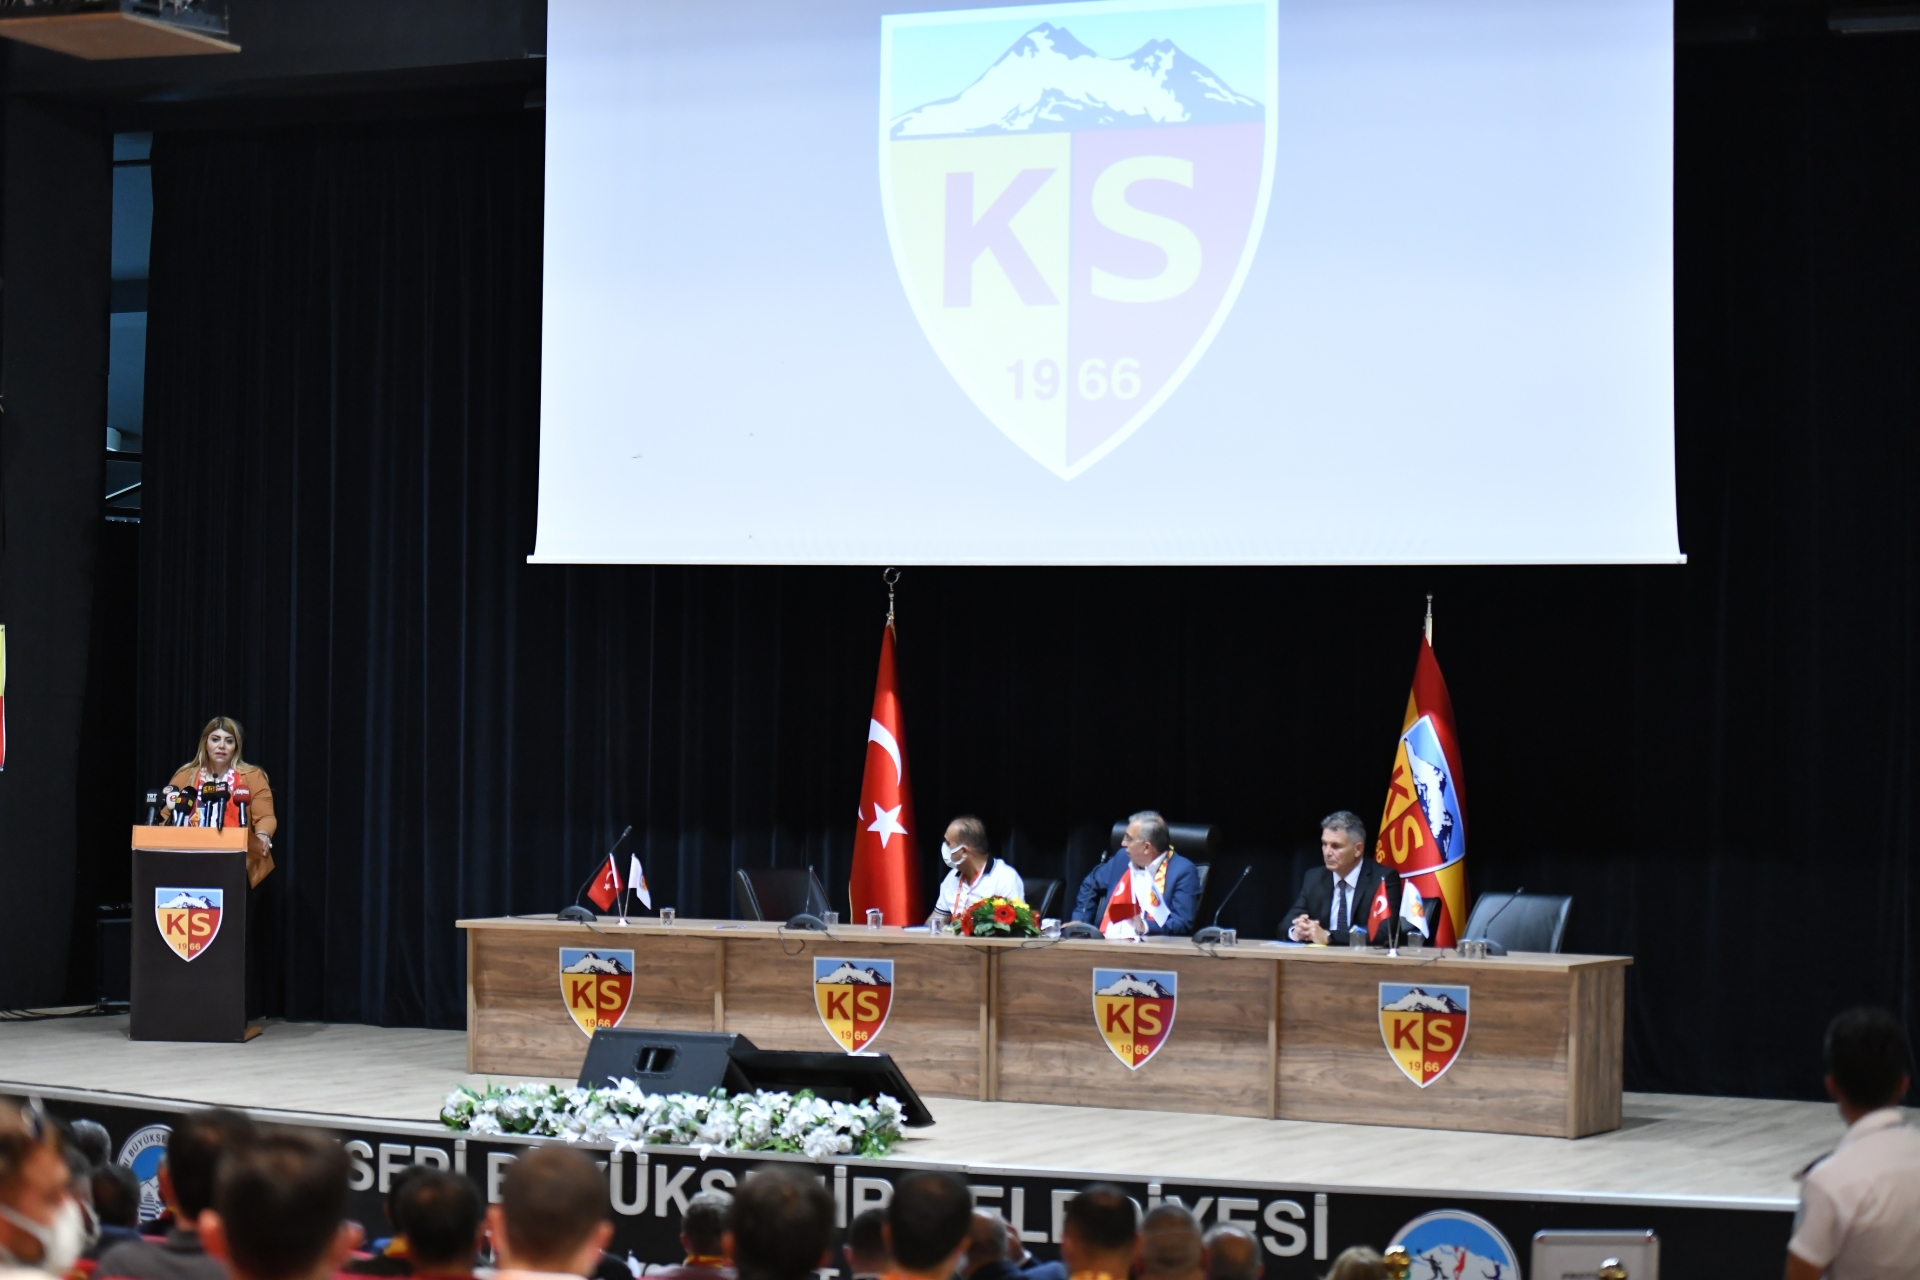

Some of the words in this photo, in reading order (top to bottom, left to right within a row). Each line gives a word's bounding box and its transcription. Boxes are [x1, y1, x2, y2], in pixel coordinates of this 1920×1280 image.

[943, 155, 1202, 308] KS
[1006, 357, 1142, 401] 1966
[166, 912, 211, 936] KS
[178, 942, 201, 951] 1966
[572, 980, 622, 1010] KS
[827, 990, 880, 1022] KS
[1106, 1003, 1162, 1035] KS
[840, 1030, 868, 1041] 1966
[1120, 1044, 1149, 1055] 1966
[1393, 1018, 1454, 1052] KS
[1408, 1061, 1440, 1073] 1966
